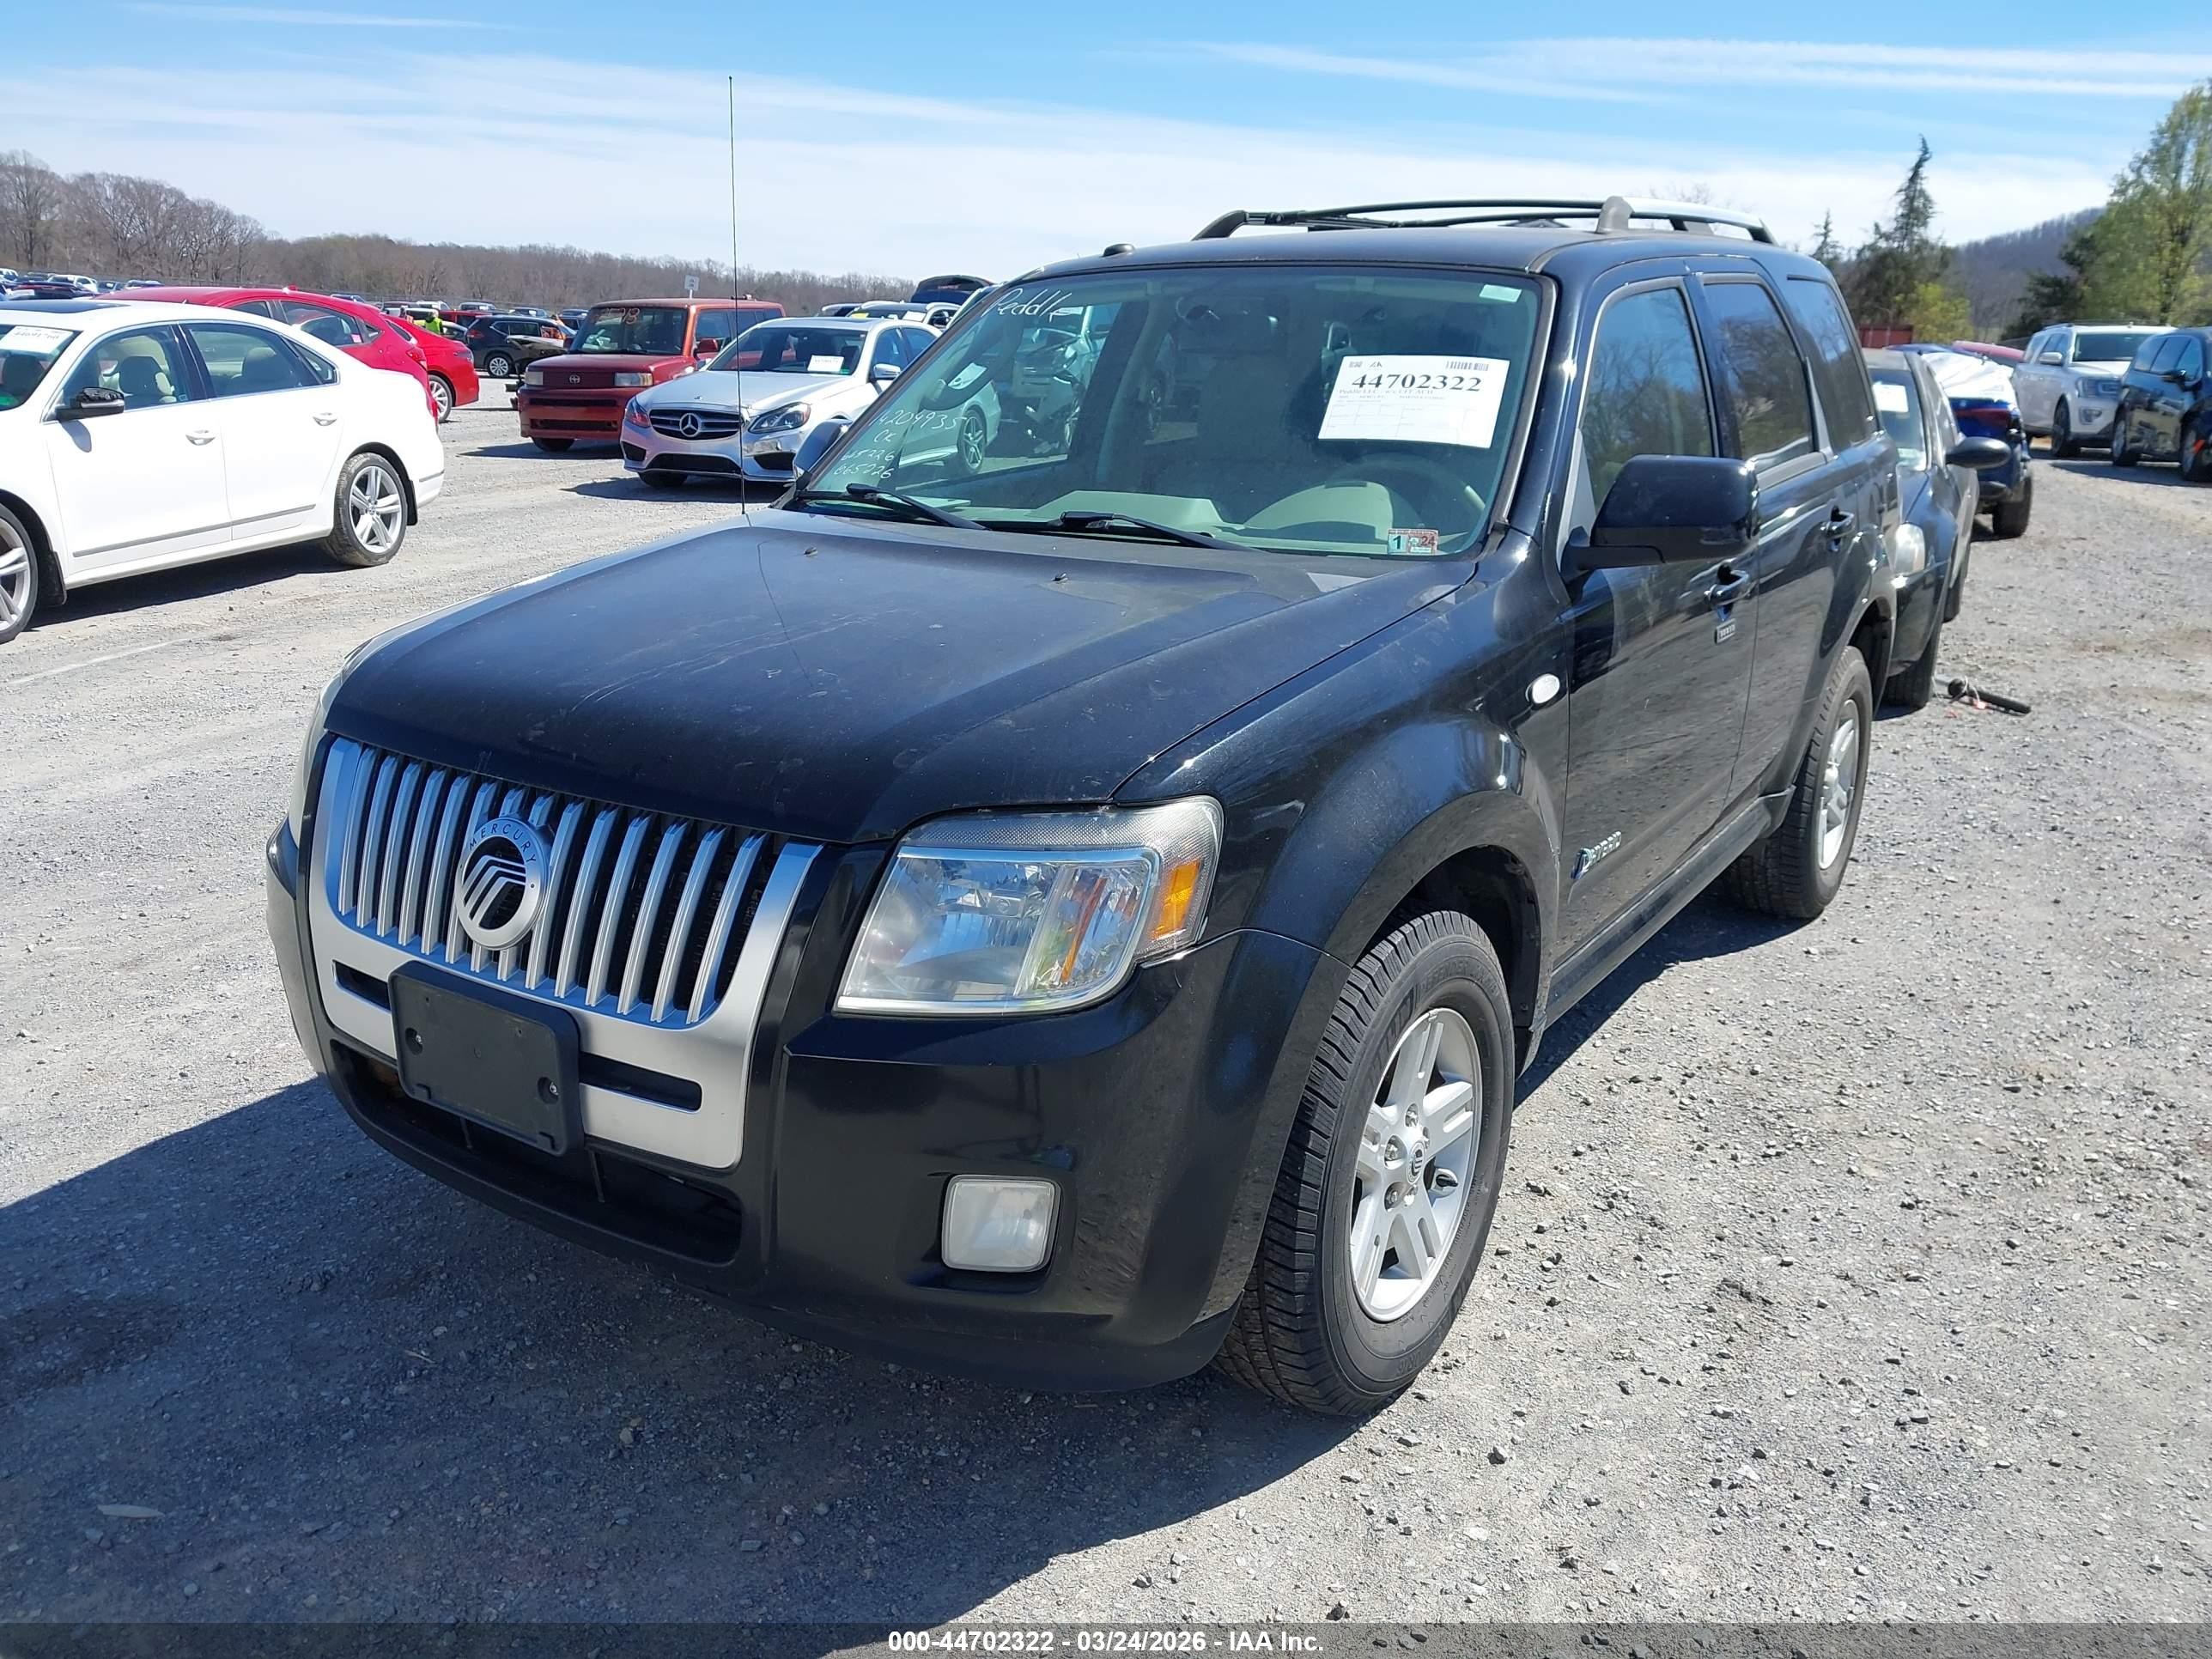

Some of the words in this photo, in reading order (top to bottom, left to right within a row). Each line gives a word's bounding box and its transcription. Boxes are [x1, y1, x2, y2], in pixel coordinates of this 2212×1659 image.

[1352, 374, 1482, 392] 44702322
[1393, 535, 1401, 550] 1
[1420, 535, 1436, 547] 24
[469, 823, 537, 863] MERCURY
